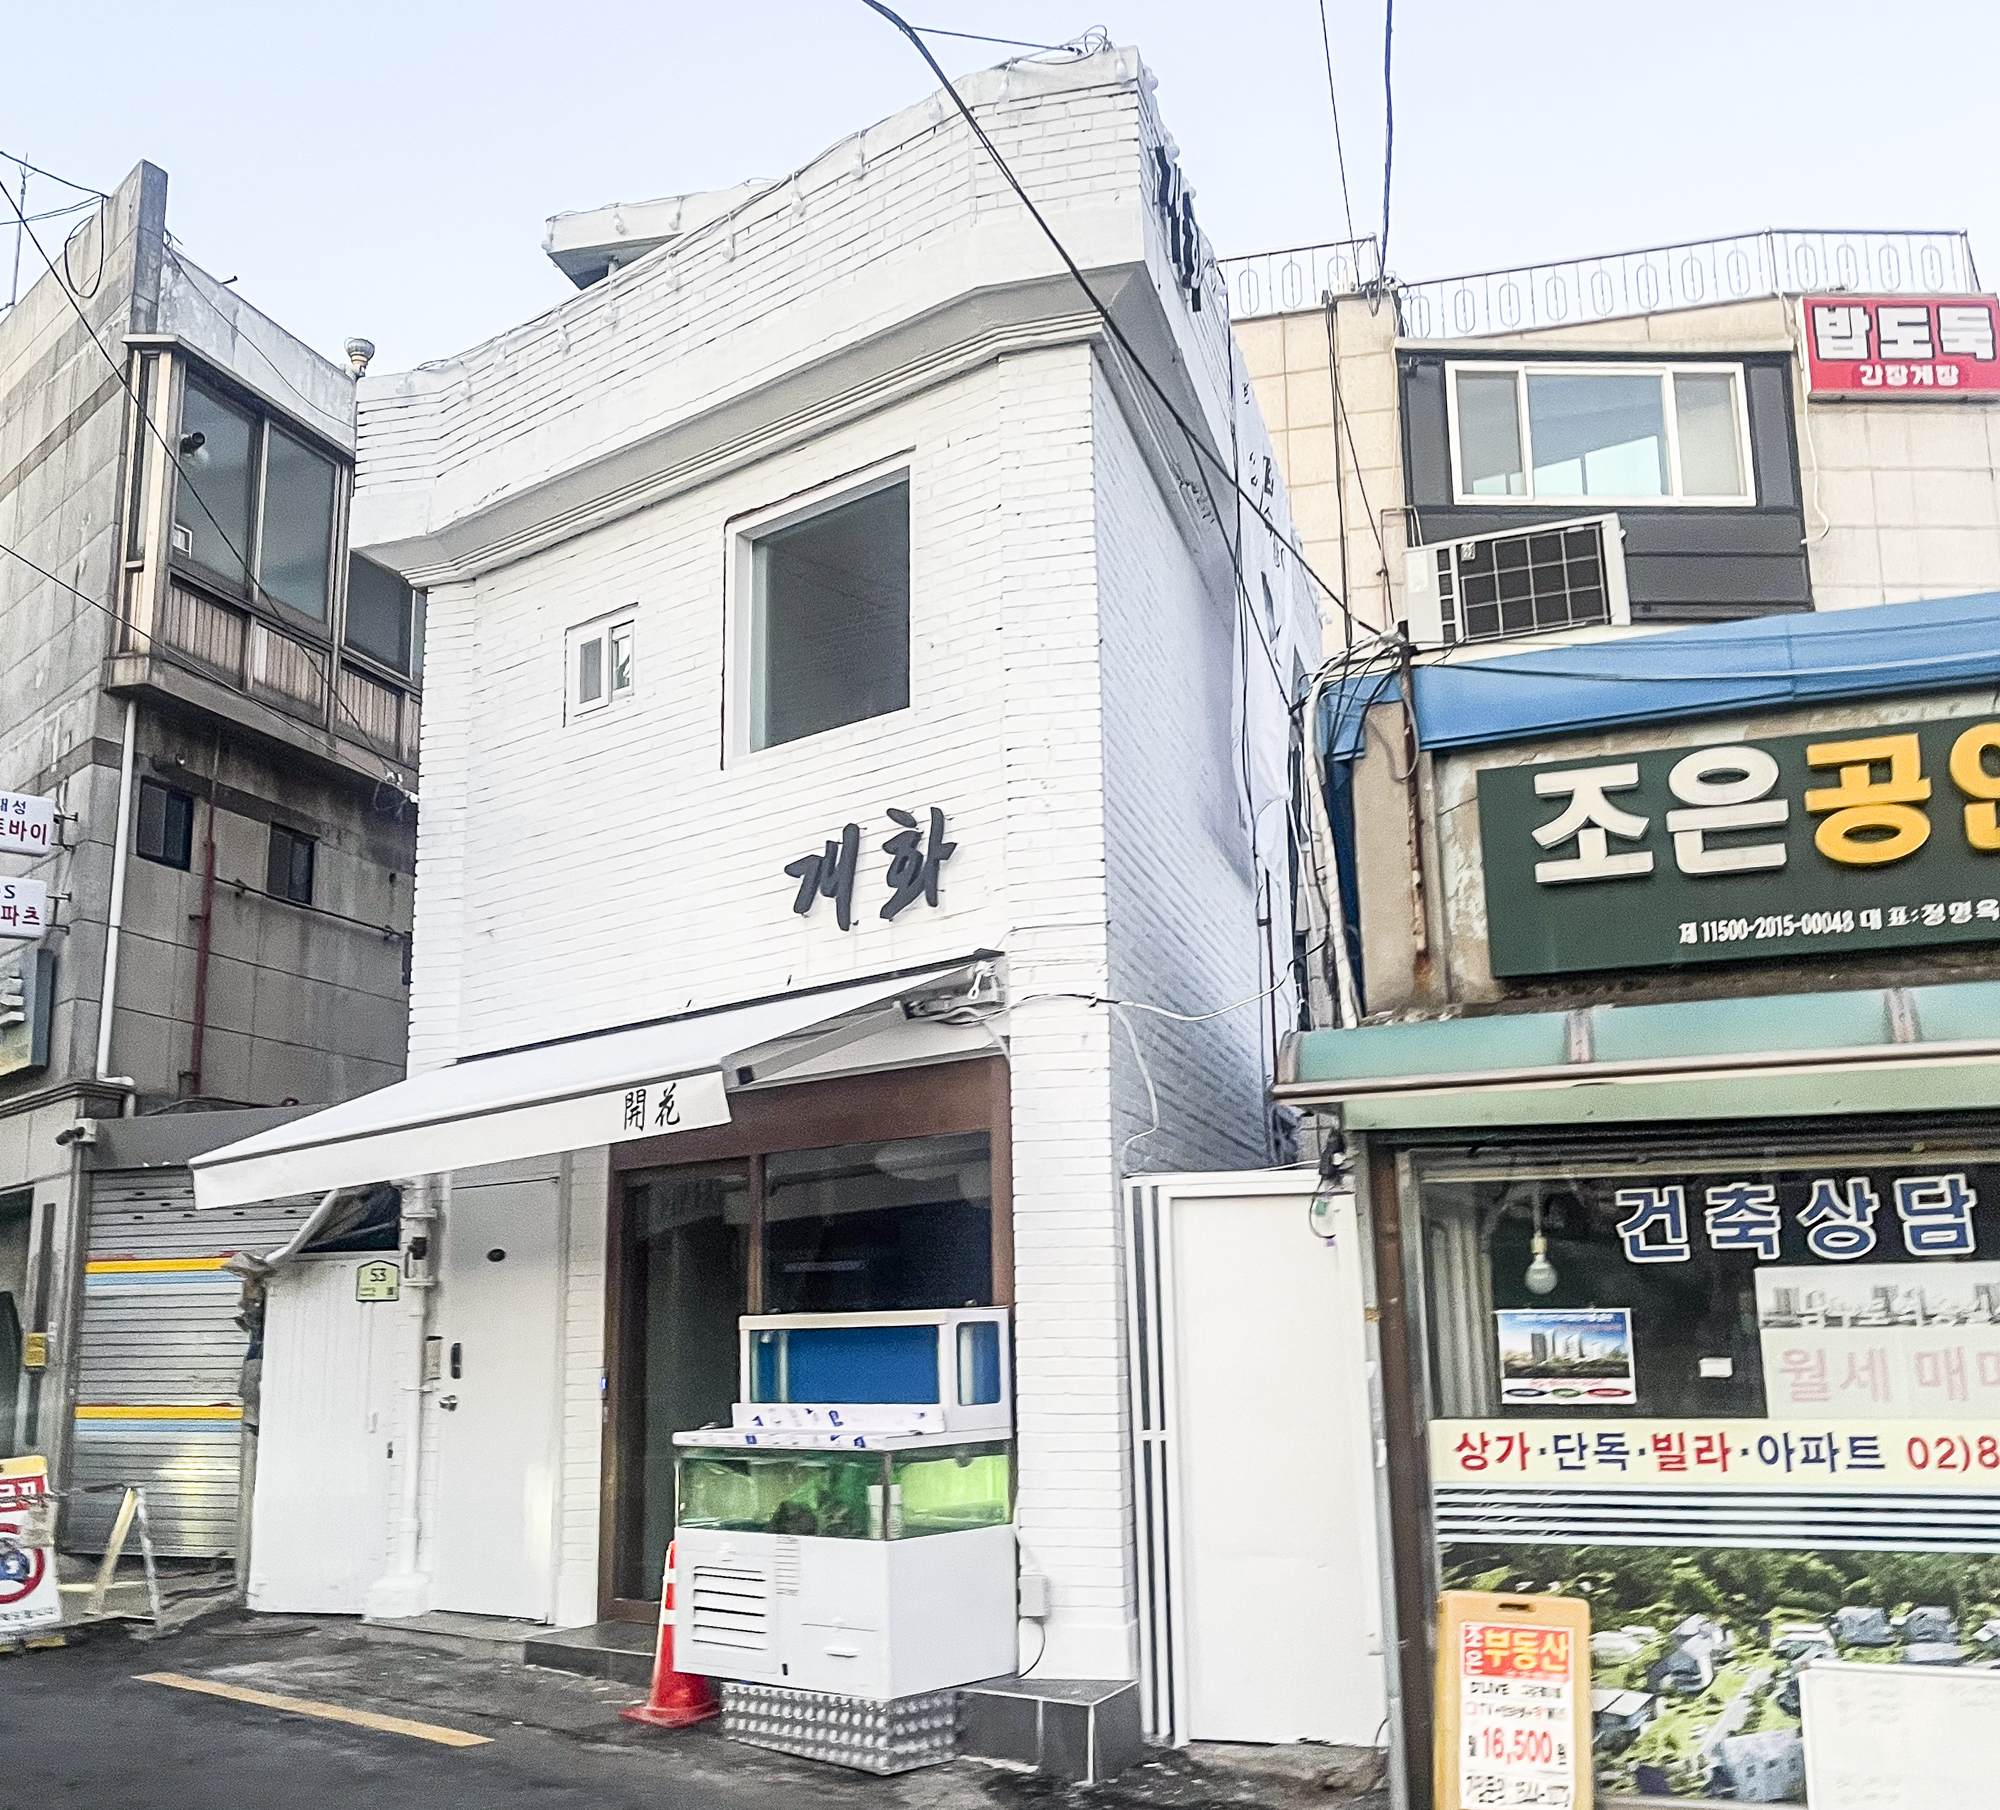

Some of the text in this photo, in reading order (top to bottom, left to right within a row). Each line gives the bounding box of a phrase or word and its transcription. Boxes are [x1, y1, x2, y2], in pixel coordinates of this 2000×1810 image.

[1813, 305, 1997, 361] 밥도둑
[784, 806, 958, 932] 개화
[623, 1082, 681, 1132] 開花
[369, 1267, 387, 1282] 53
[1483, 1628, 1570, 1673] 부동산
